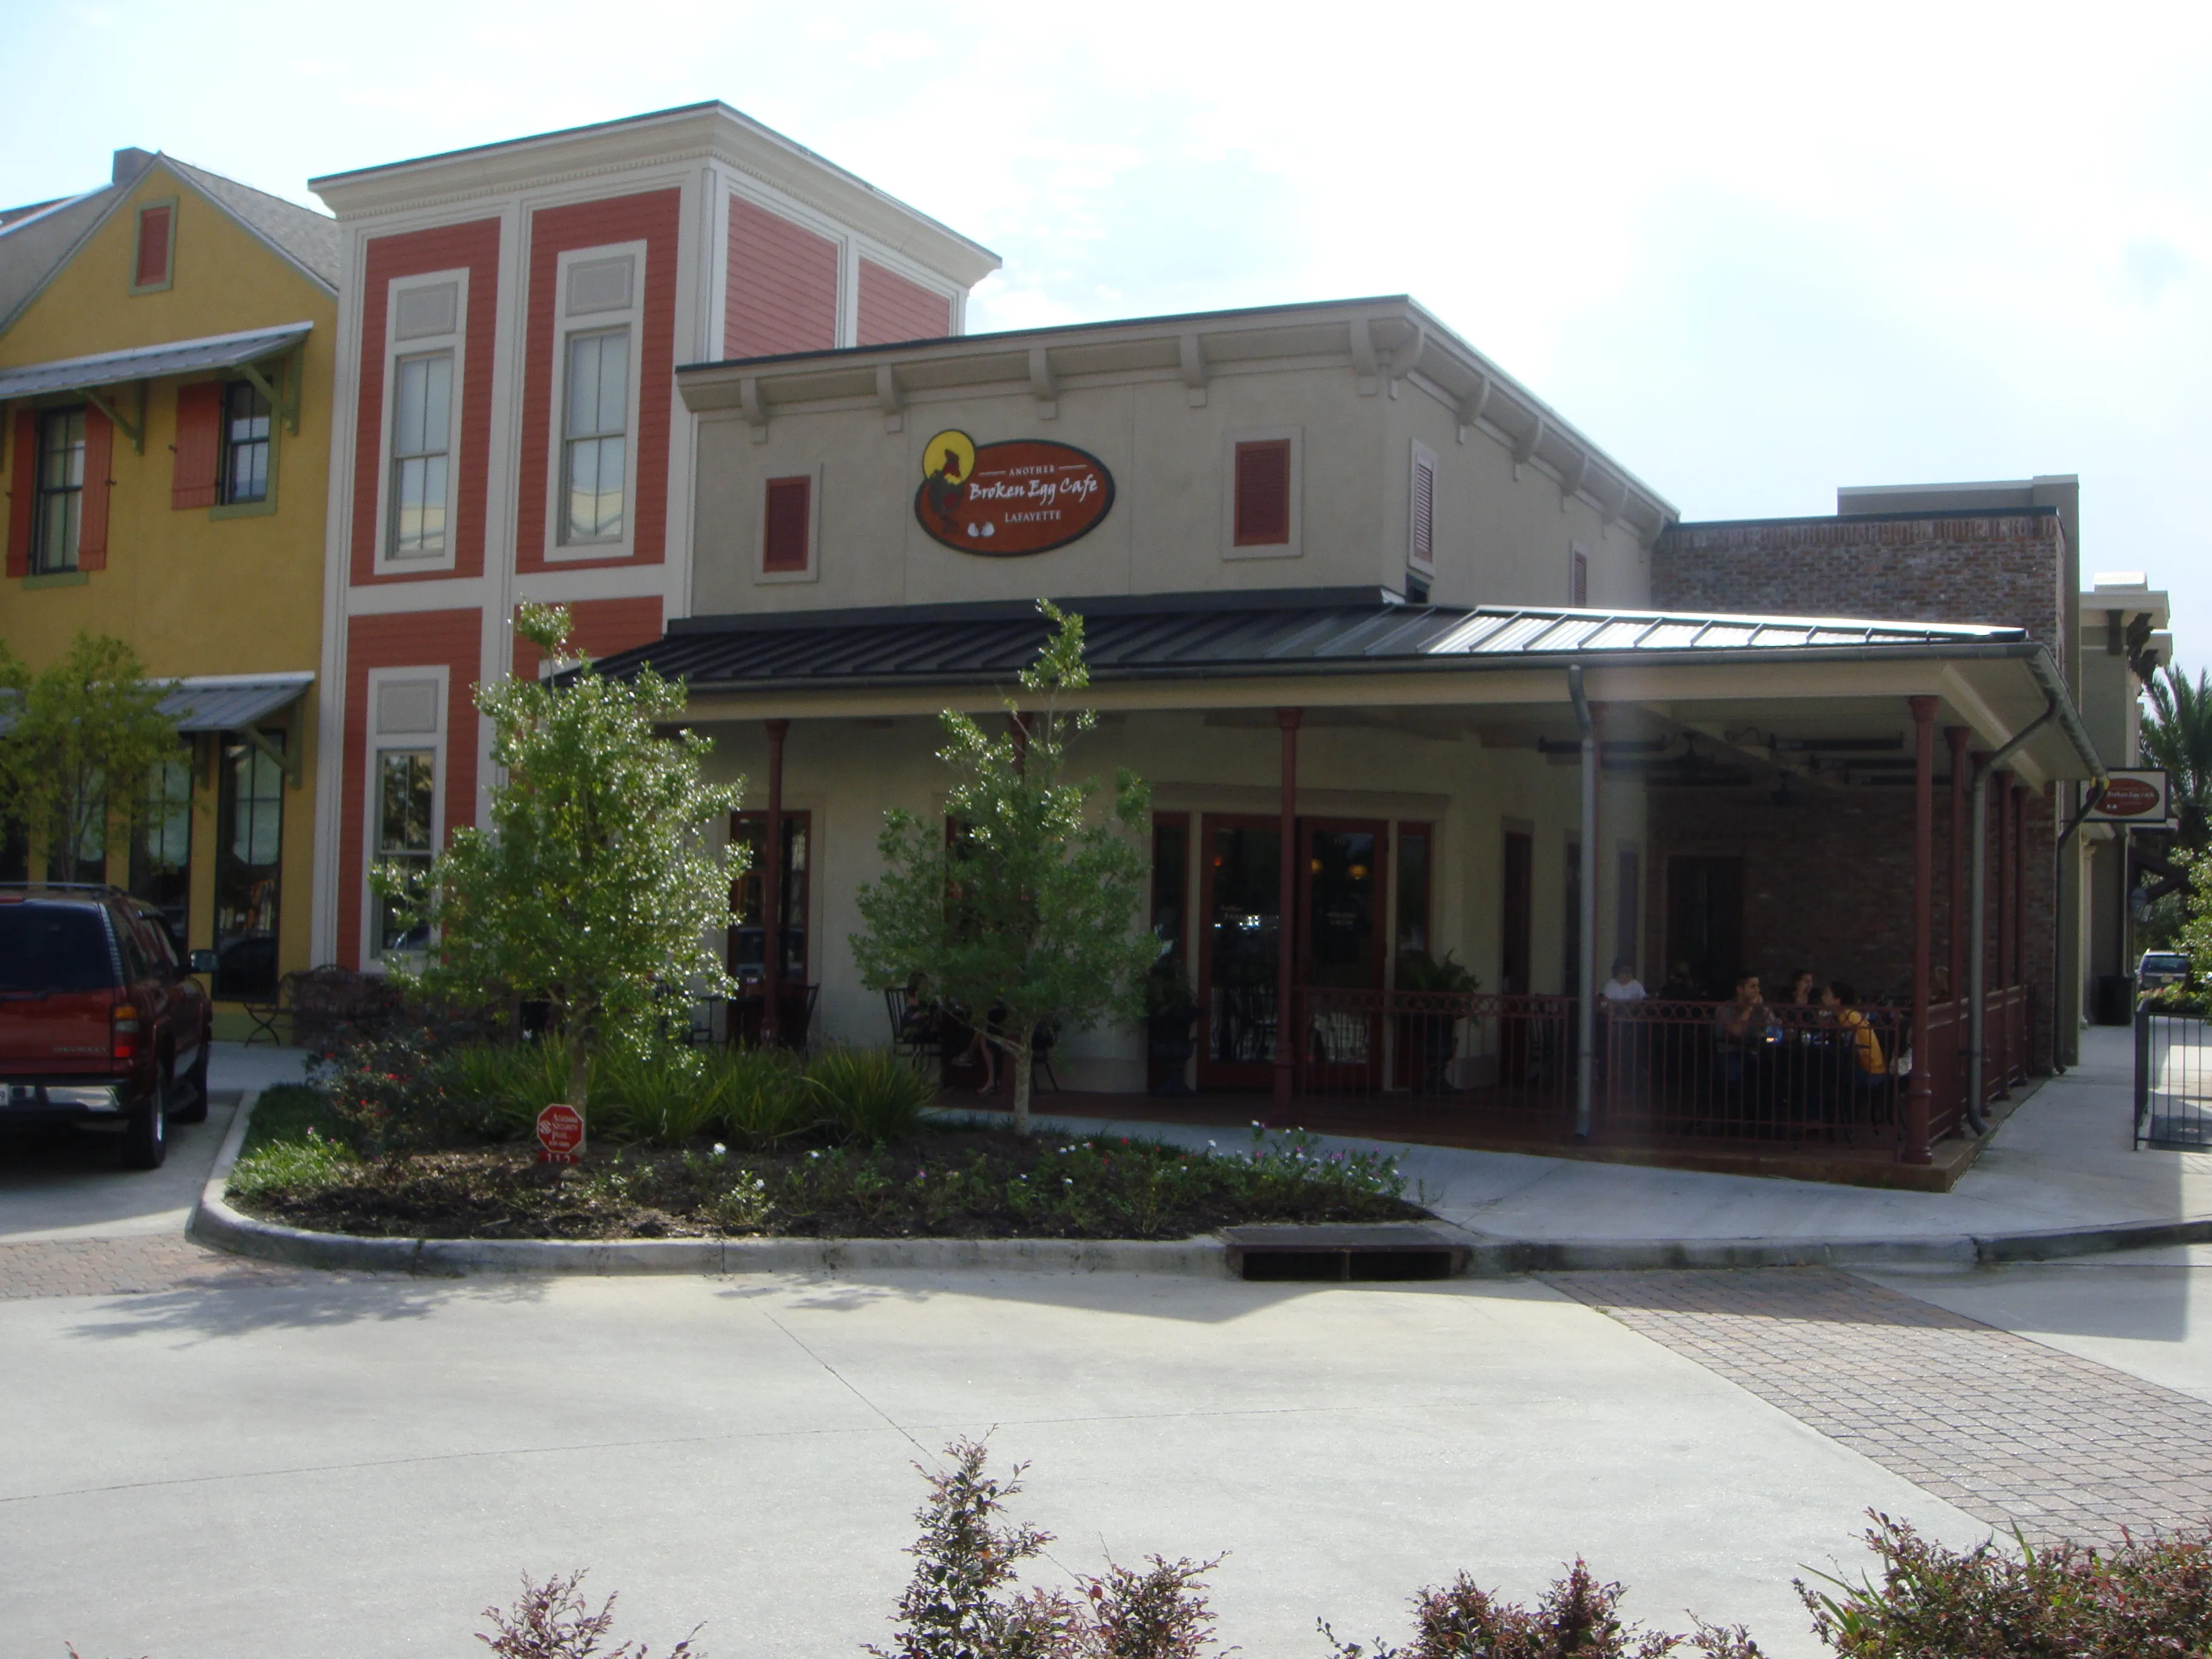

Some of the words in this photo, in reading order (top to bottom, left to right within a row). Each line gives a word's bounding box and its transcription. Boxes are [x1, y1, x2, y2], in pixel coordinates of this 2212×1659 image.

[1009, 464, 1055, 476] ANOTHER
[970, 480, 1024, 500] Broken
[1028, 480, 1056, 506] Egg
[1060, 474, 1098, 503] Cafe
[1005, 510, 1061, 523] LAFAYETTE
